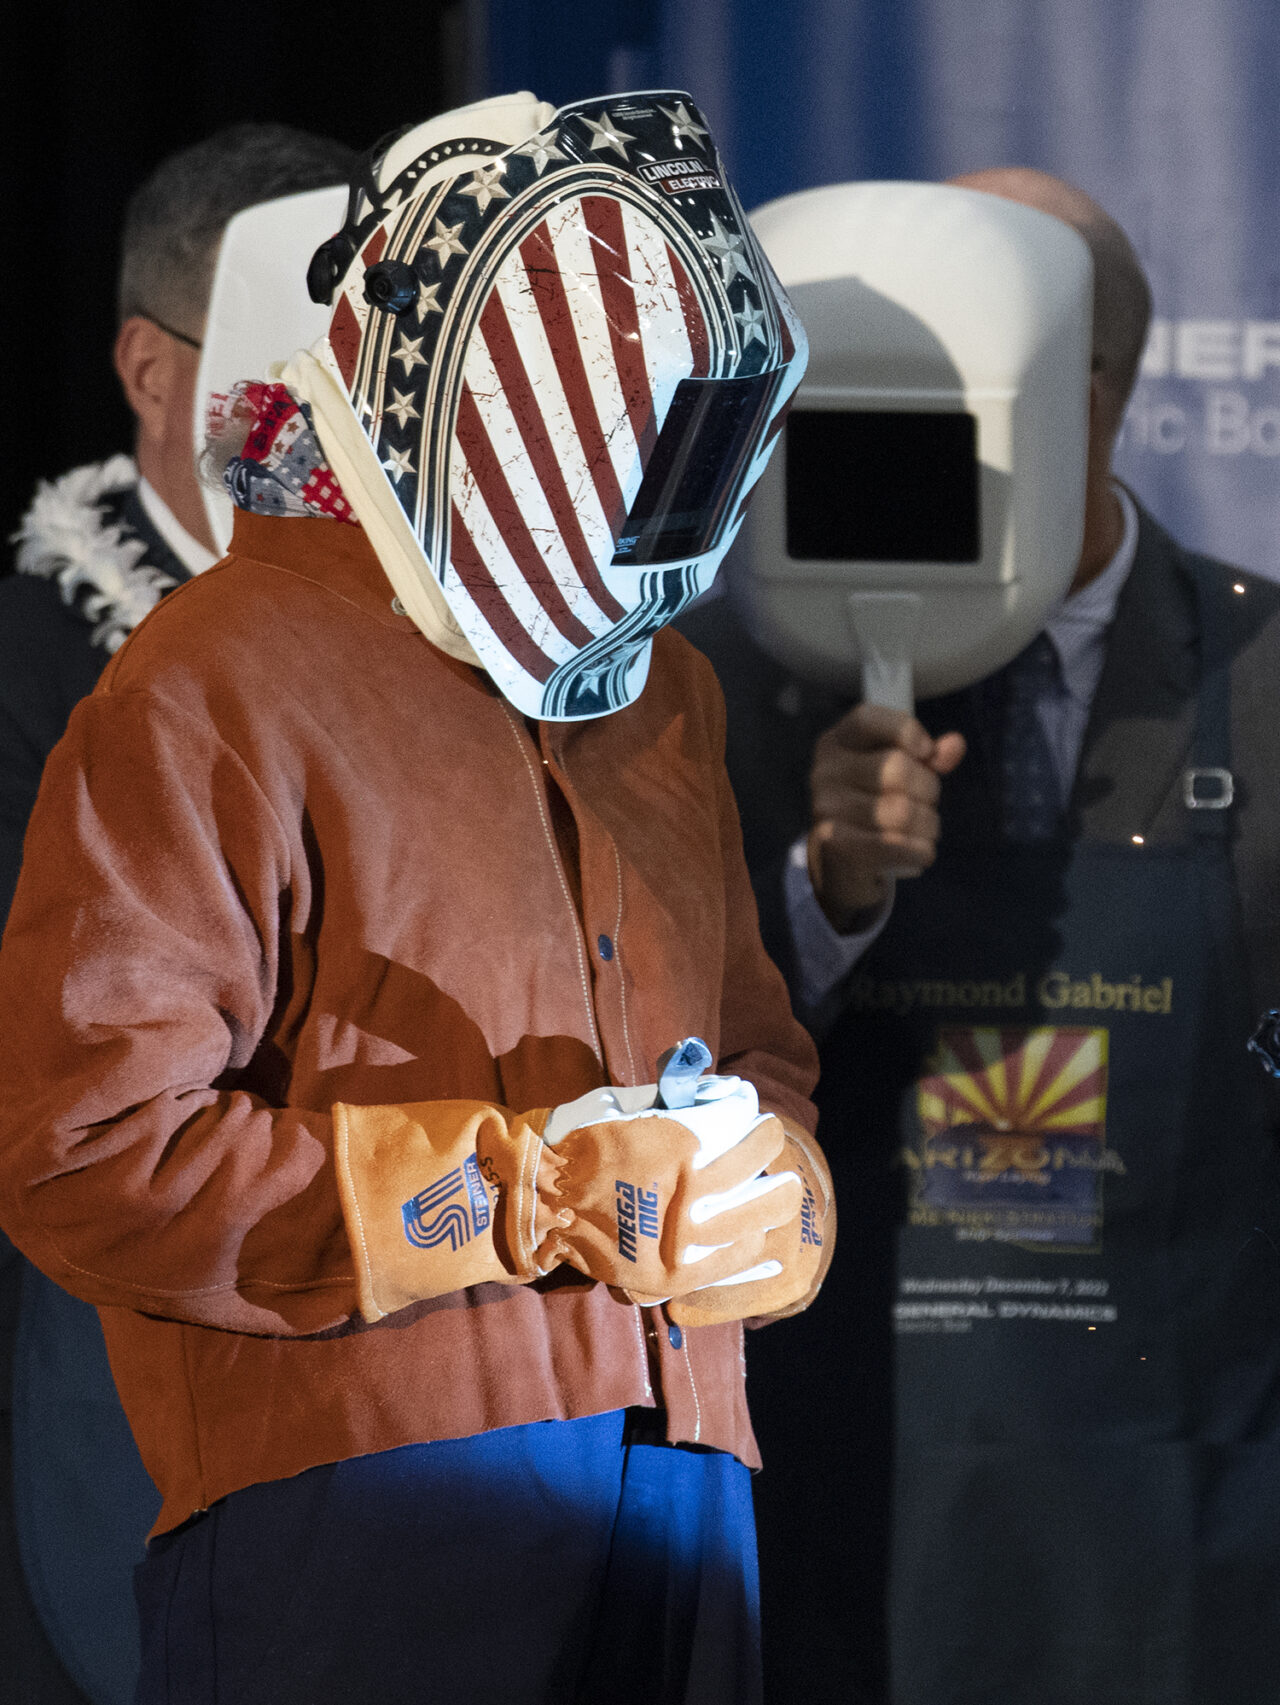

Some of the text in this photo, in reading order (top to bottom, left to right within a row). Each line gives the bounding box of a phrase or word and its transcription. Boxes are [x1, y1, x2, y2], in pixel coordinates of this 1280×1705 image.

[642, 160, 705, 181] LINCOLN
[667, 176, 720, 191] ELECTRIC
[1040, 971, 1172, 1013] Gabriel
[894, 1146, 1127, 1176] ARIZONA
[466, 1162, 489, 1228] STEINER
[637, 1187, 658, 1239] MIG
[615, 1180, 637, 1263] MEGA
